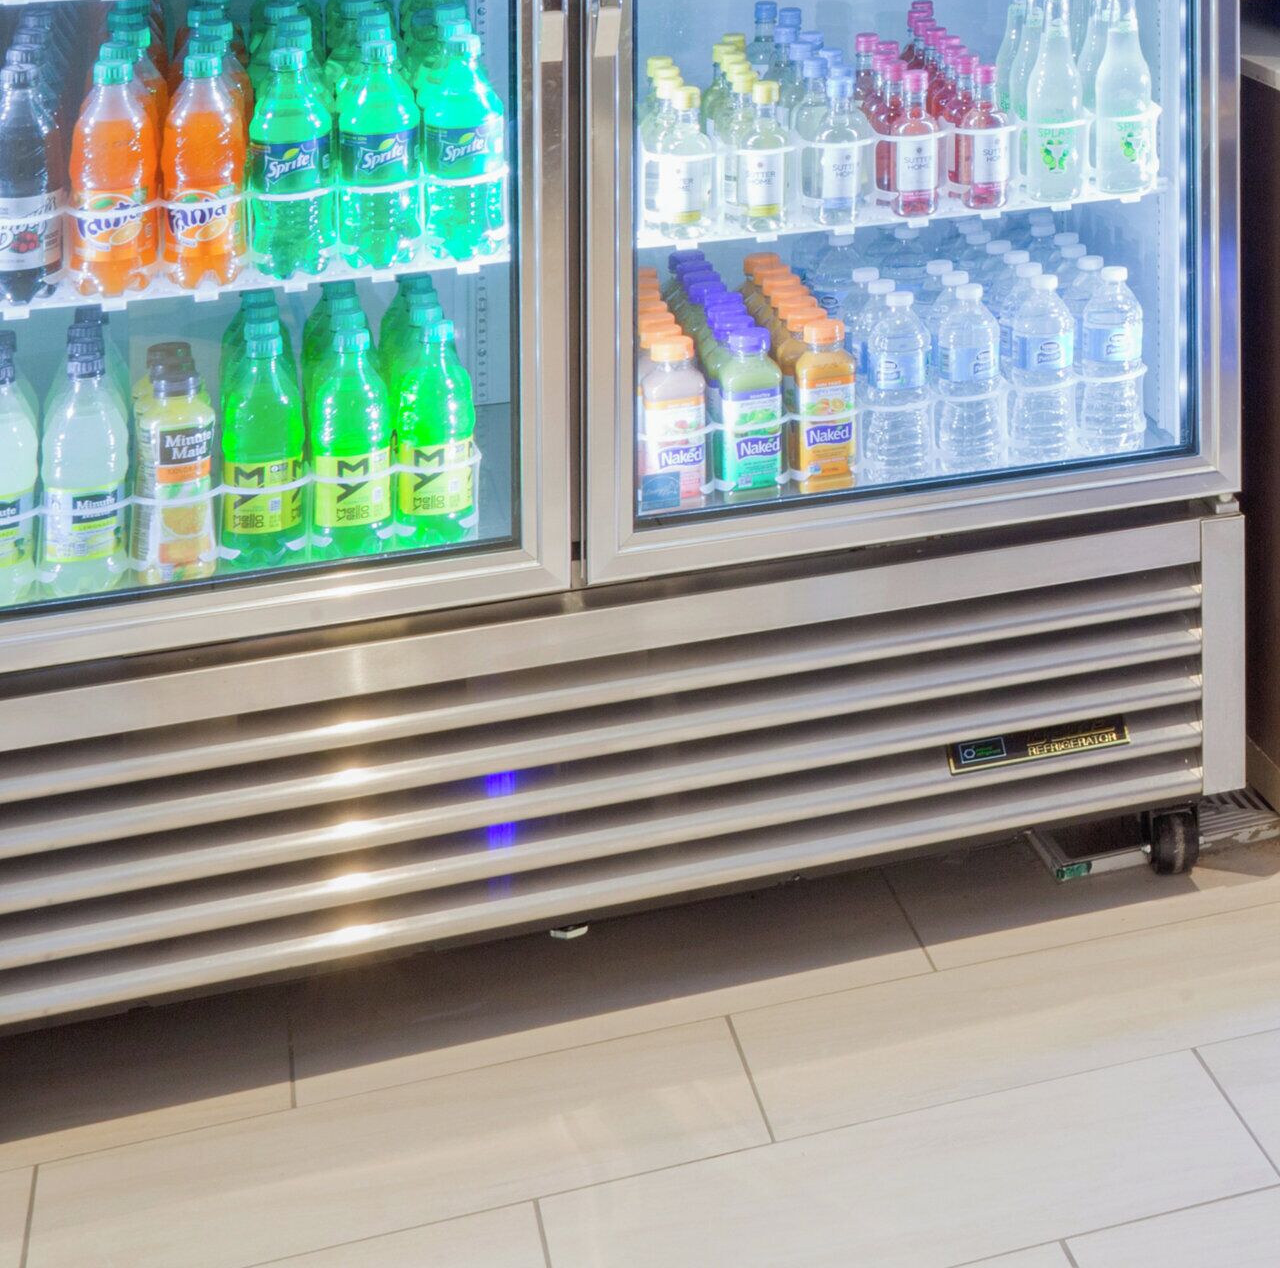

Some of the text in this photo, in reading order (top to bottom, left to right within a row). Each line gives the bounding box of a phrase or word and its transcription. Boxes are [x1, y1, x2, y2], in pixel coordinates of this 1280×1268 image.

[362, 141, 405, 170] Sprite
[443, 137, 485, 162] Sprite
[268, 152, 312, 179] Sprite
[165, 430, 213, 448] Minute
[810, 426, 850, 446] Naked
[171, 445, 208, 461] Maid
[741, 437, 780, 457] Naked
[661, 448, 703, 467] Naked
[233, 514, 264, 522] Mello
[337, 506, 370, 516] Mello
[337, 512, 370, 522] Yello
[233, 521, 264, 529] Yello
[1028, 732, 1118, 756] REFRIGERATOR
